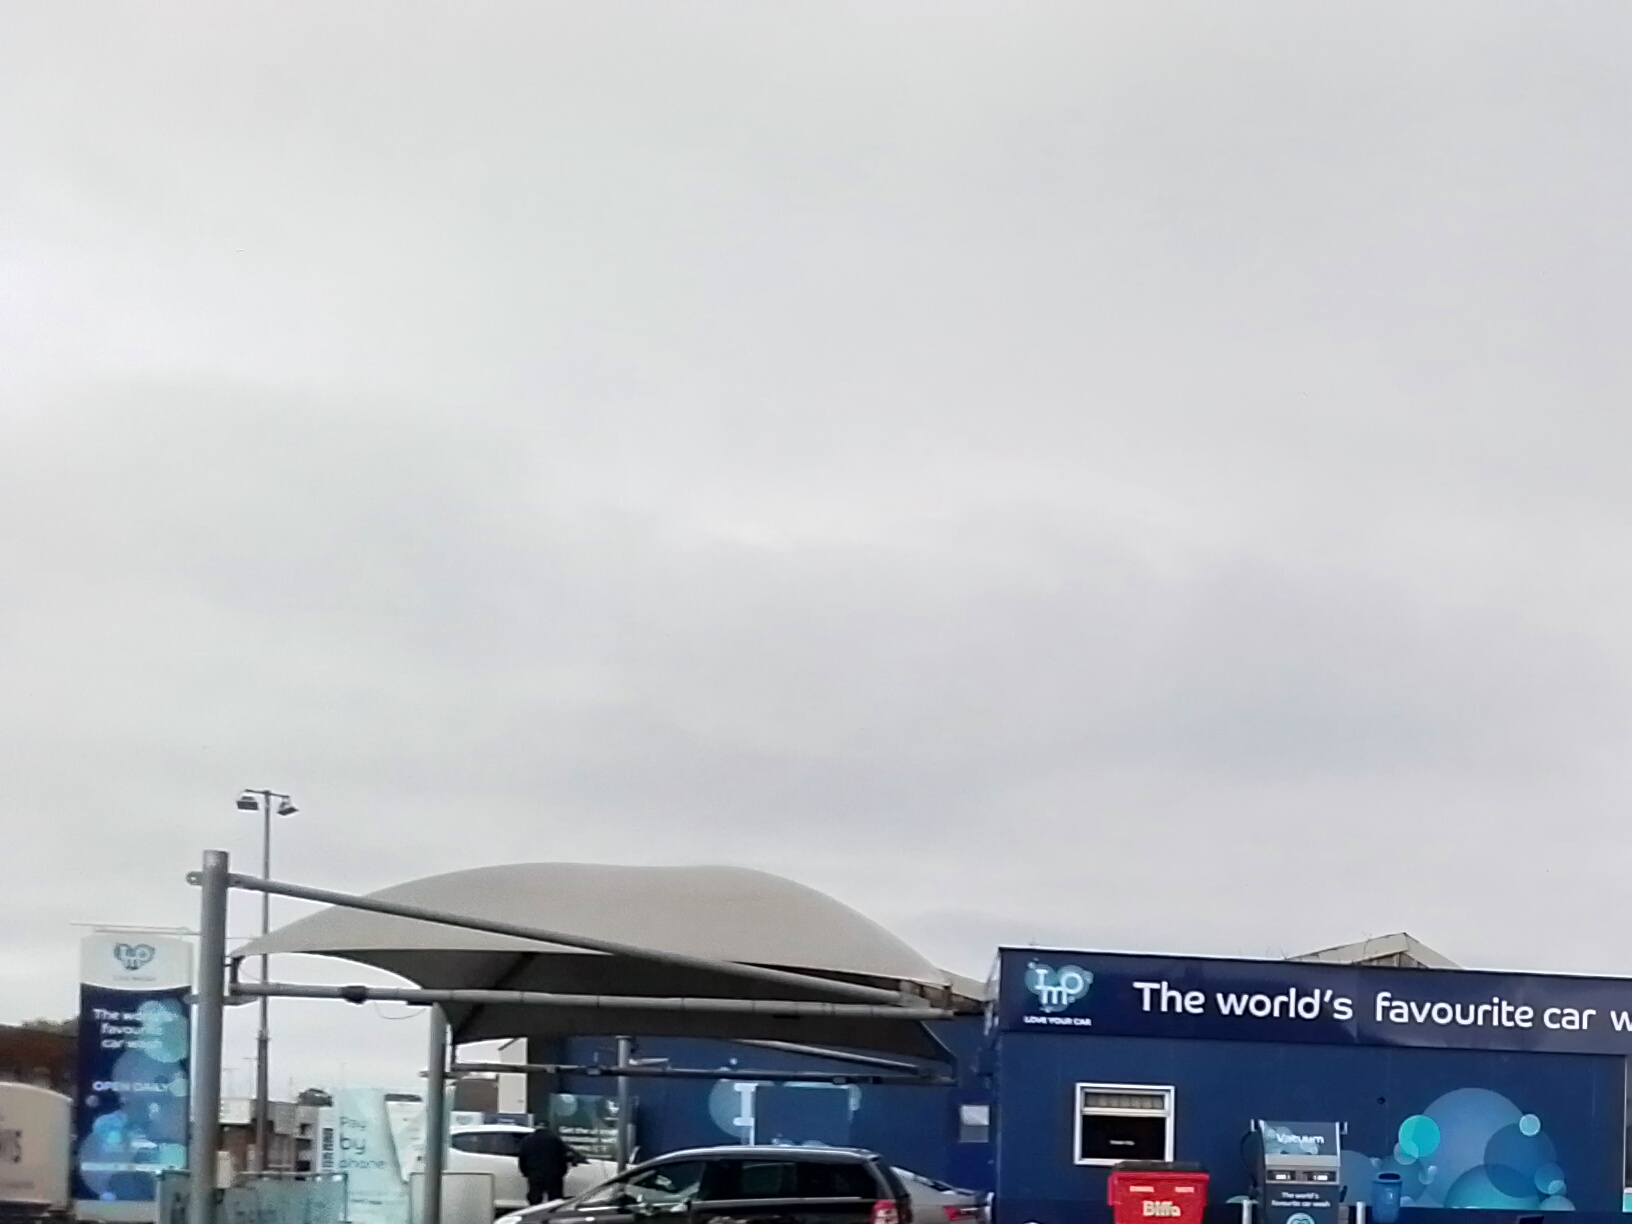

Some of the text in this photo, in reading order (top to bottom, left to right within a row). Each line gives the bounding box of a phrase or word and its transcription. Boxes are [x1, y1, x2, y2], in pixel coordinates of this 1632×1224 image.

[1132, 981, 1206, 1015] The
[1215, 987, 1354, 1020] world's
[1375, 991, 1534, 1028] favourite
[1543, 1006, 1597, 1031] car
[1023, 1015, 1092, 1026] LOVE YOUR CAR
[1276, 1133, 1325, 1145] Vacuum
[1142, 1200, 1181, 1217] Biffa
